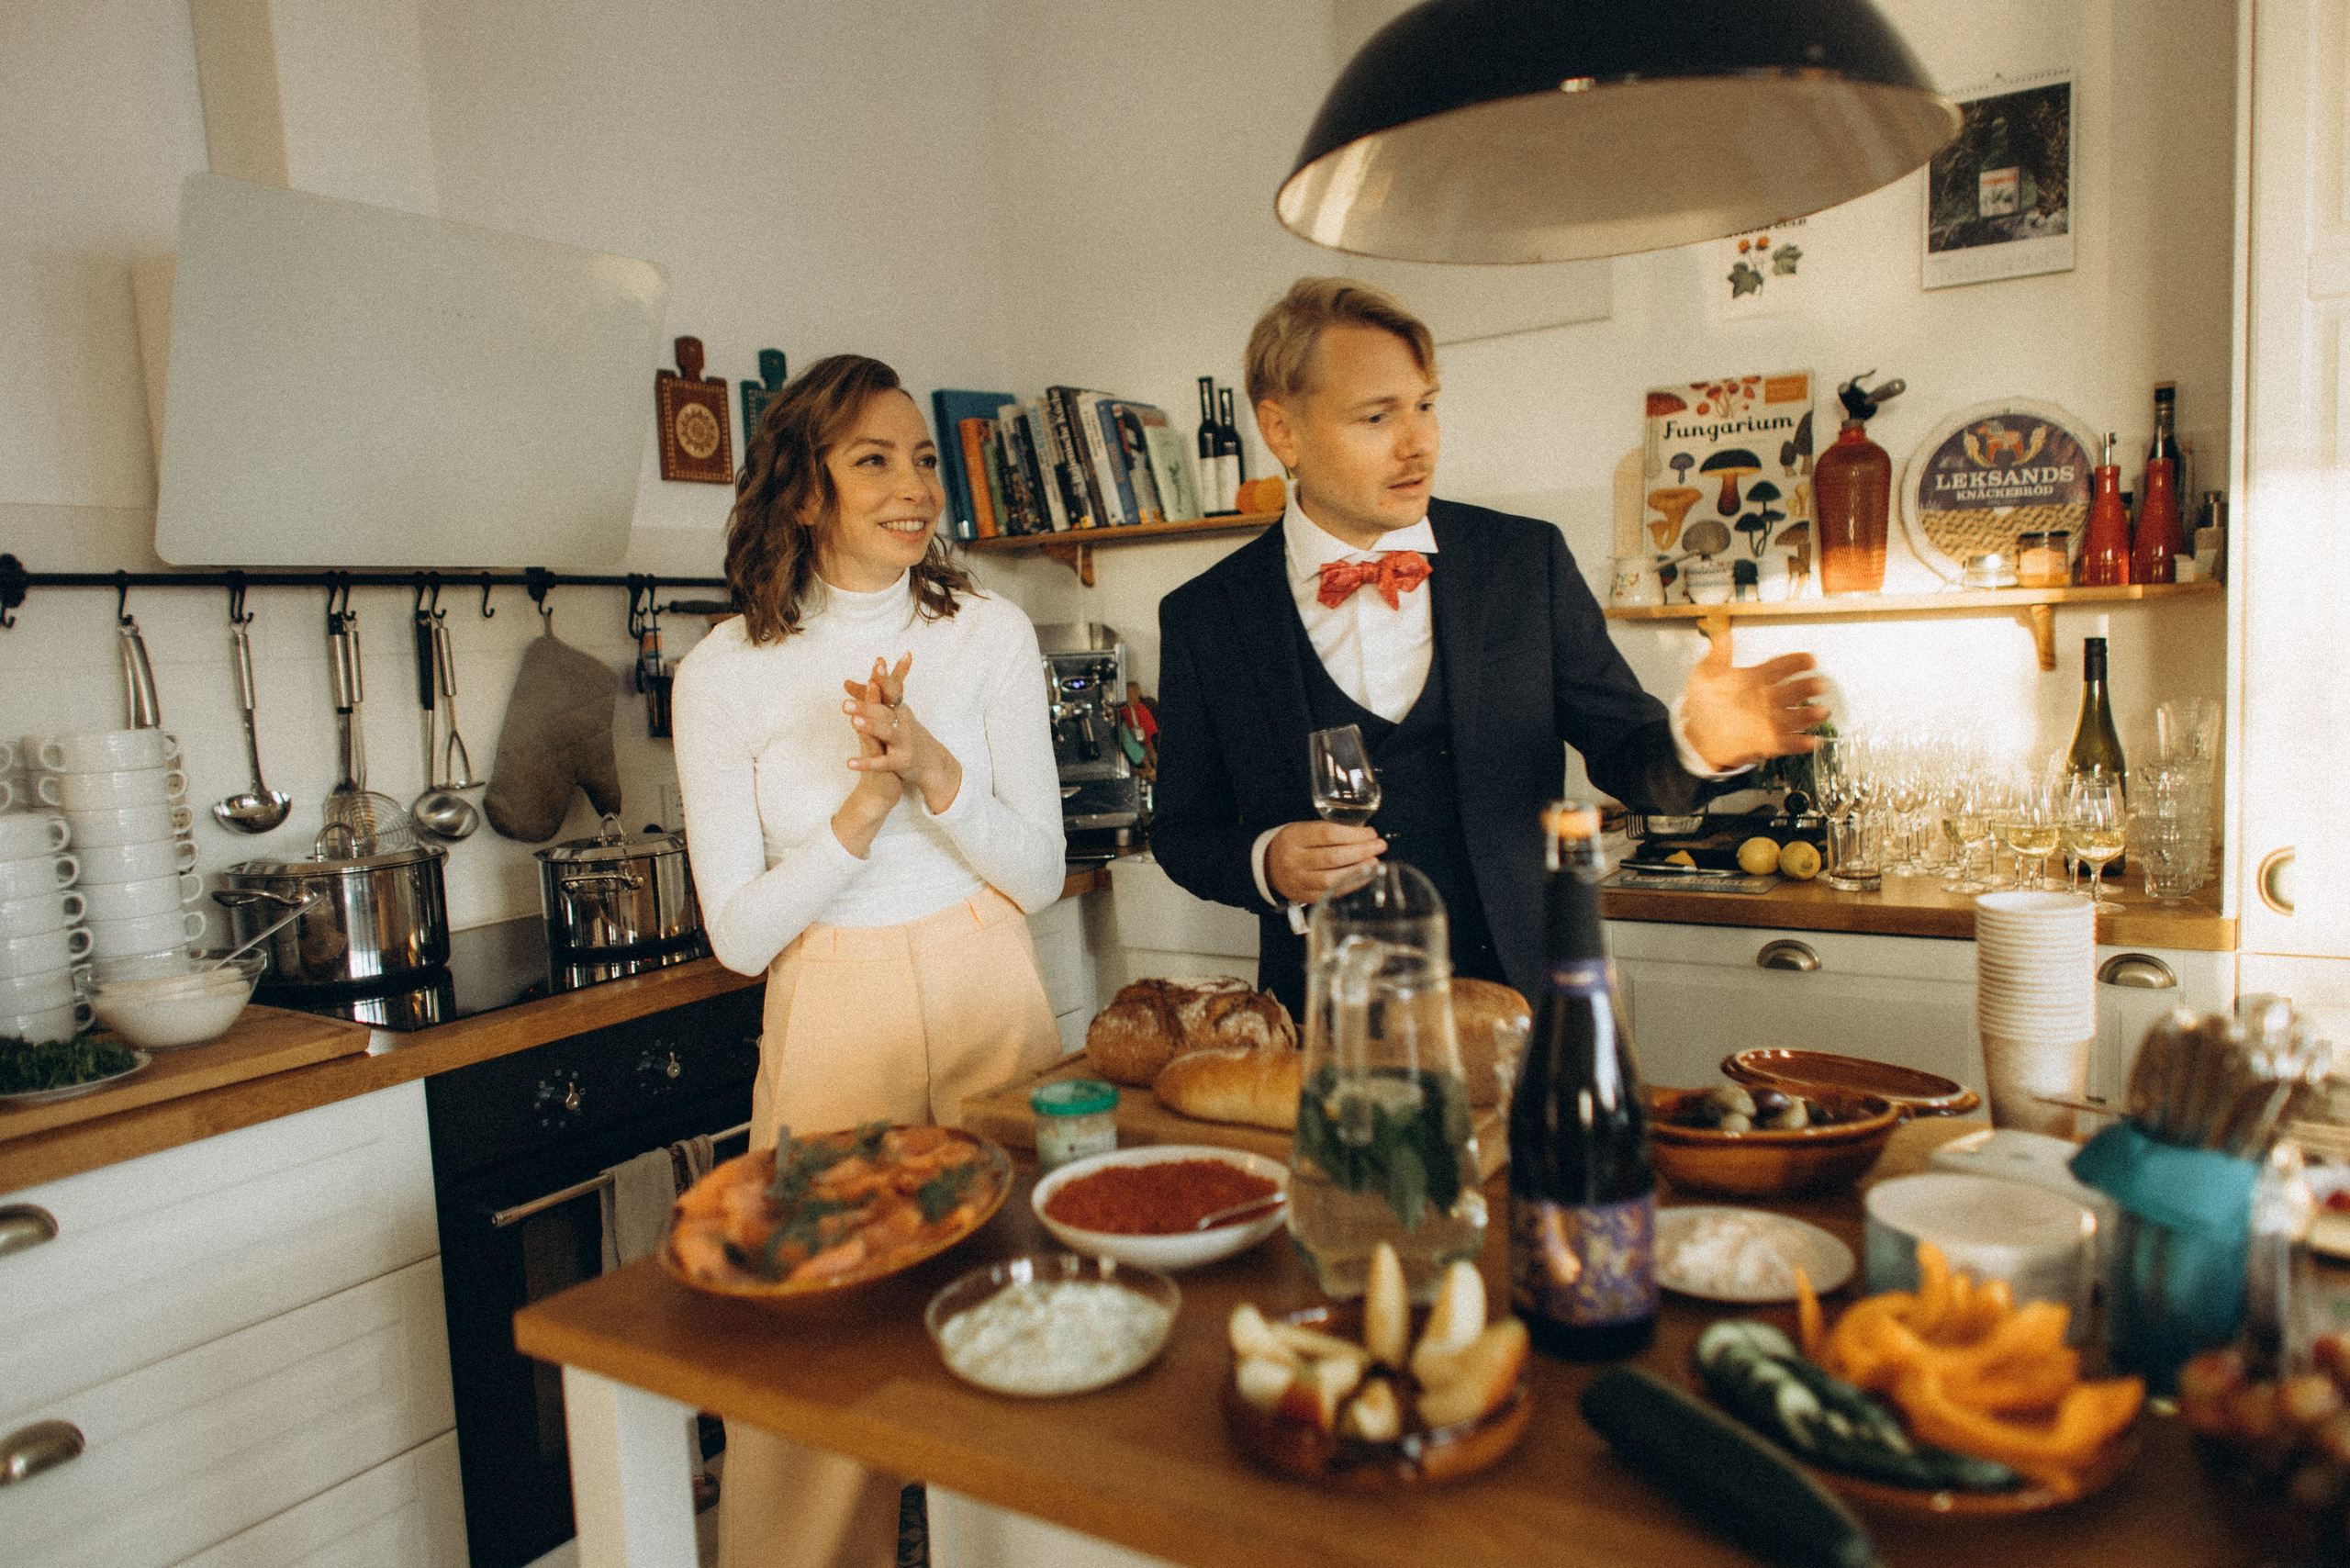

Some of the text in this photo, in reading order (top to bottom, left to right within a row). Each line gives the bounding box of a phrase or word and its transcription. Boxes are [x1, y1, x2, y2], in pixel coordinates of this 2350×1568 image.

[1663, 416, 1795, 442] Fungarium
[1935, 465, 2075, 491] LEKSANDS
[1956, 484, 2053, 501] KNÄCKEBRÖD
